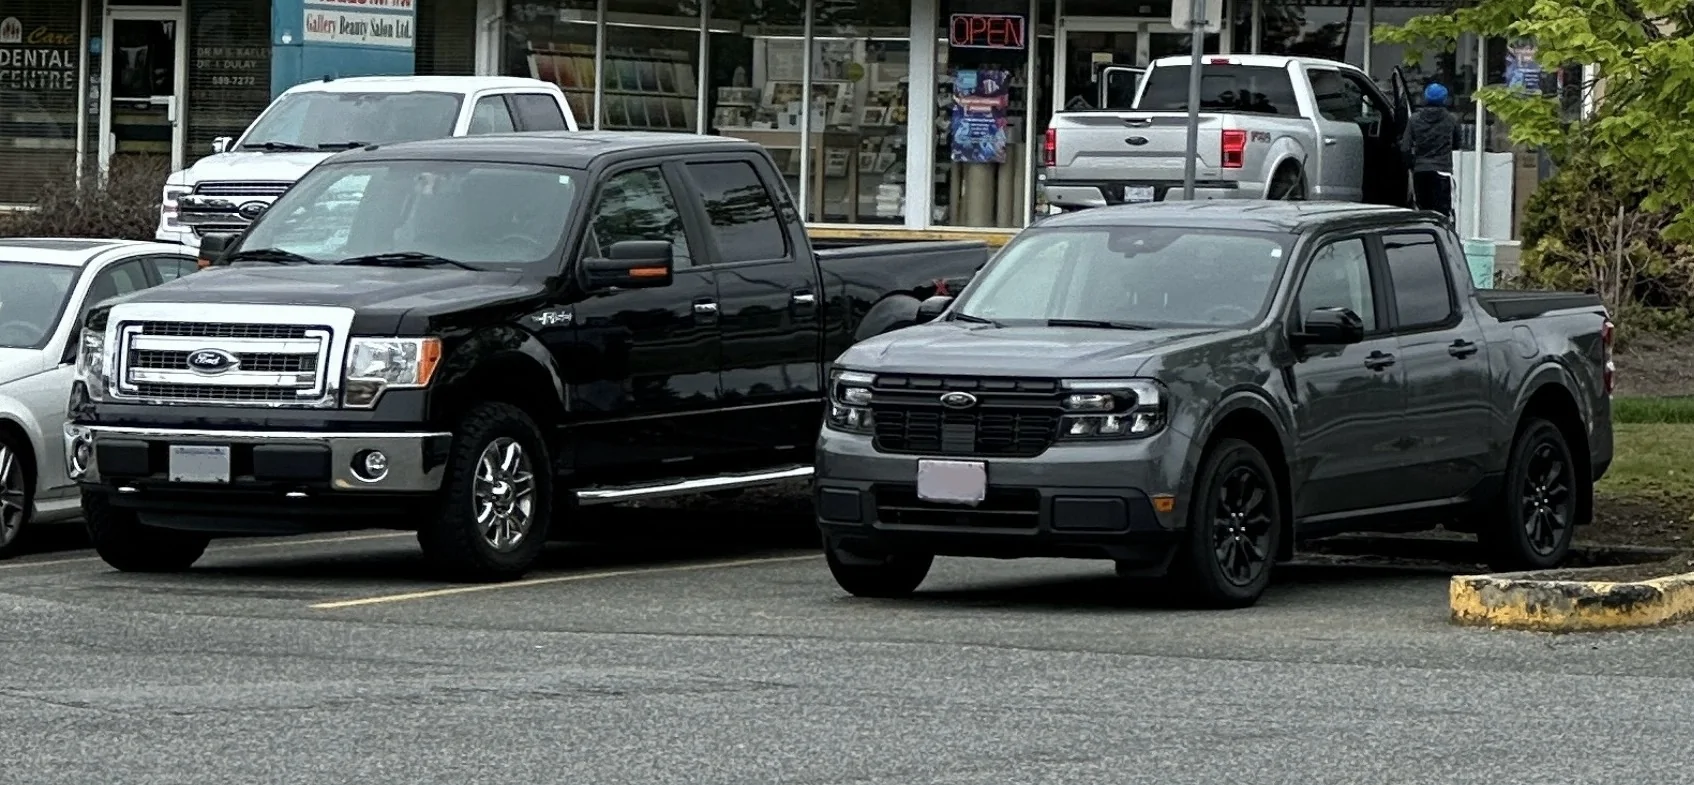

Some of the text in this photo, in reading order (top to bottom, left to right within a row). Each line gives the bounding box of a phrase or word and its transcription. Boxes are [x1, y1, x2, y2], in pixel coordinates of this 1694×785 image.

[306, 13, 336, 39] Gallery
[340, 15, 367, 41] Beauty
[370, 17, 394, 38] Salon
[953, 16, 1024, 47] OPEN
[0, 49, 74, 68] DENTAL
[224, 60, 257, 69] DULAY
[0, 70, 74, 89] CENTRE
[194, 352, 221, 366] Ford
